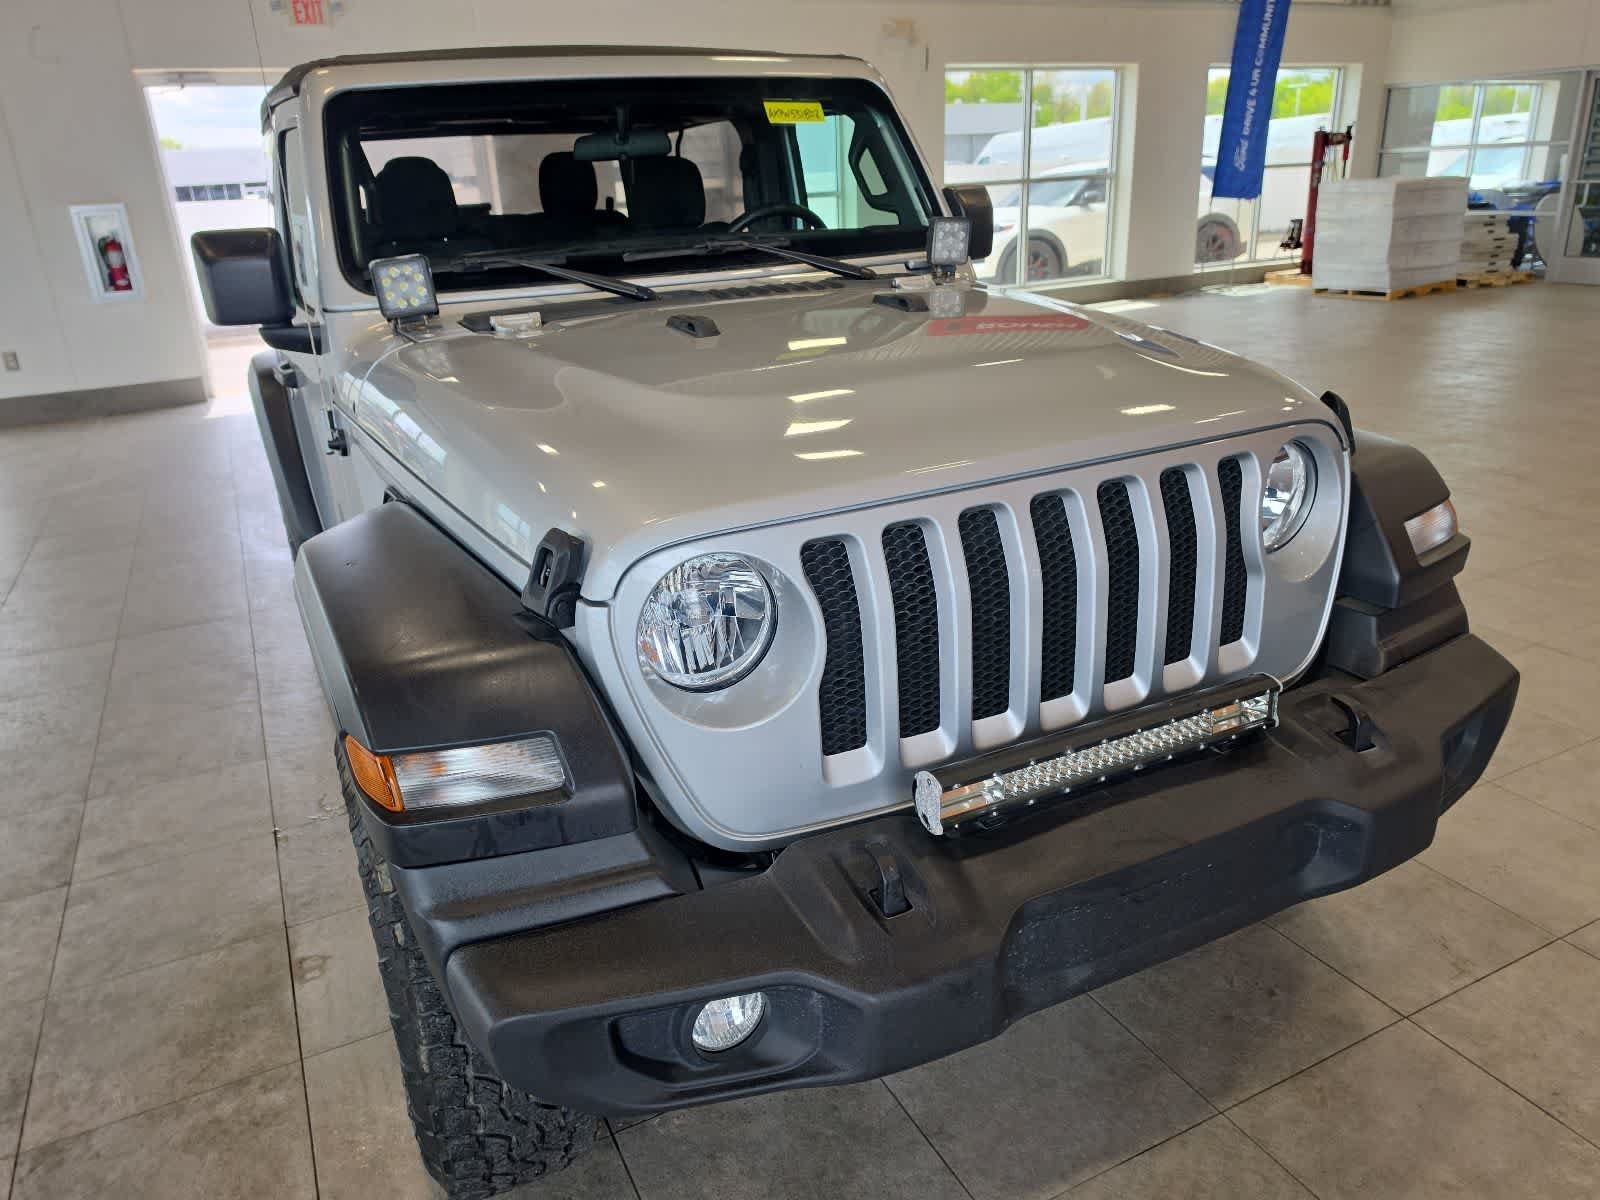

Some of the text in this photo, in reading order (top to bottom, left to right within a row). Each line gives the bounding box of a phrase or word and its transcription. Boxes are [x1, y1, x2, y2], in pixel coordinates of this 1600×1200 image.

[292, 0, 325, 25] EXIT
[1234, 138, 1249, 172] Ford
[1243, 99, 1257, 135] DRIVE
[1250, 69, 1261, 87] UR
